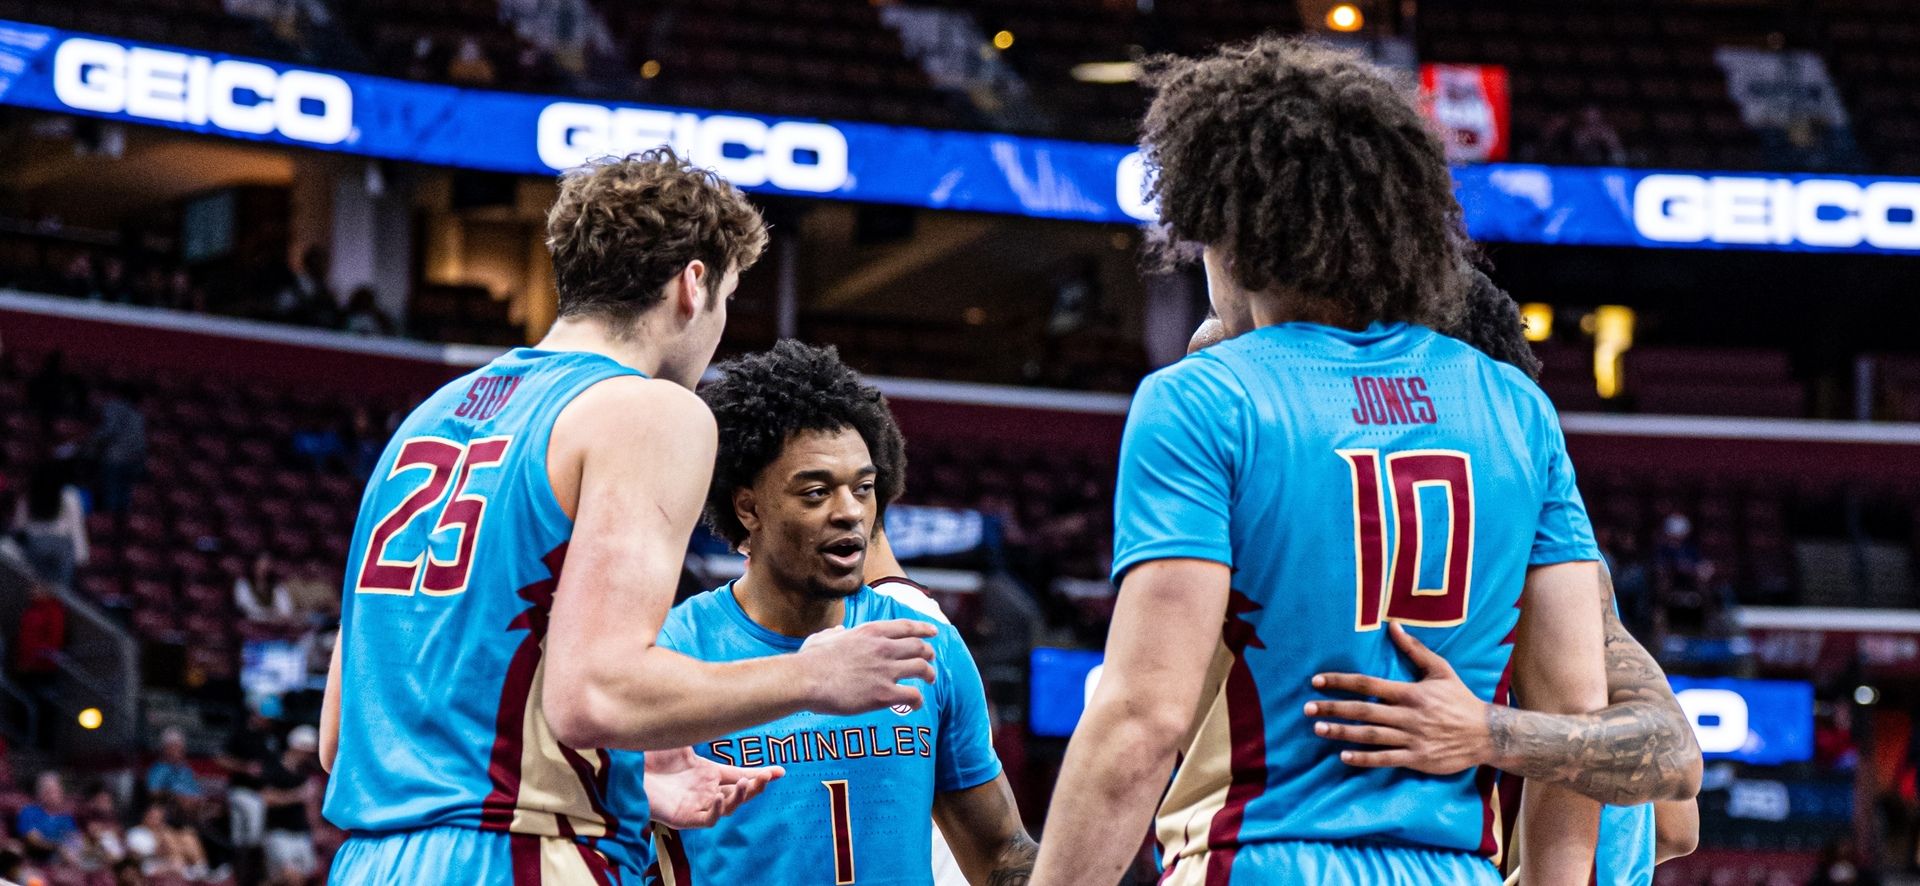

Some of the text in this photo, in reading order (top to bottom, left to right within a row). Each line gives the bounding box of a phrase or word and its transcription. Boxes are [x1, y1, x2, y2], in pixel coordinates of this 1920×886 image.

[54, 38, 353, 144] GEICO
[537, 102, 848, 193] GEICO
[1633, 174, 1920, 250] GEICO
[1352, 376, 1437, 425] JONES
[355, 435, 514, 597] 25
[1334, 448, 1475, 632] 10
[710, 726, 931, 767] SEMINOLES
[821, 779, 855, 886] 1
